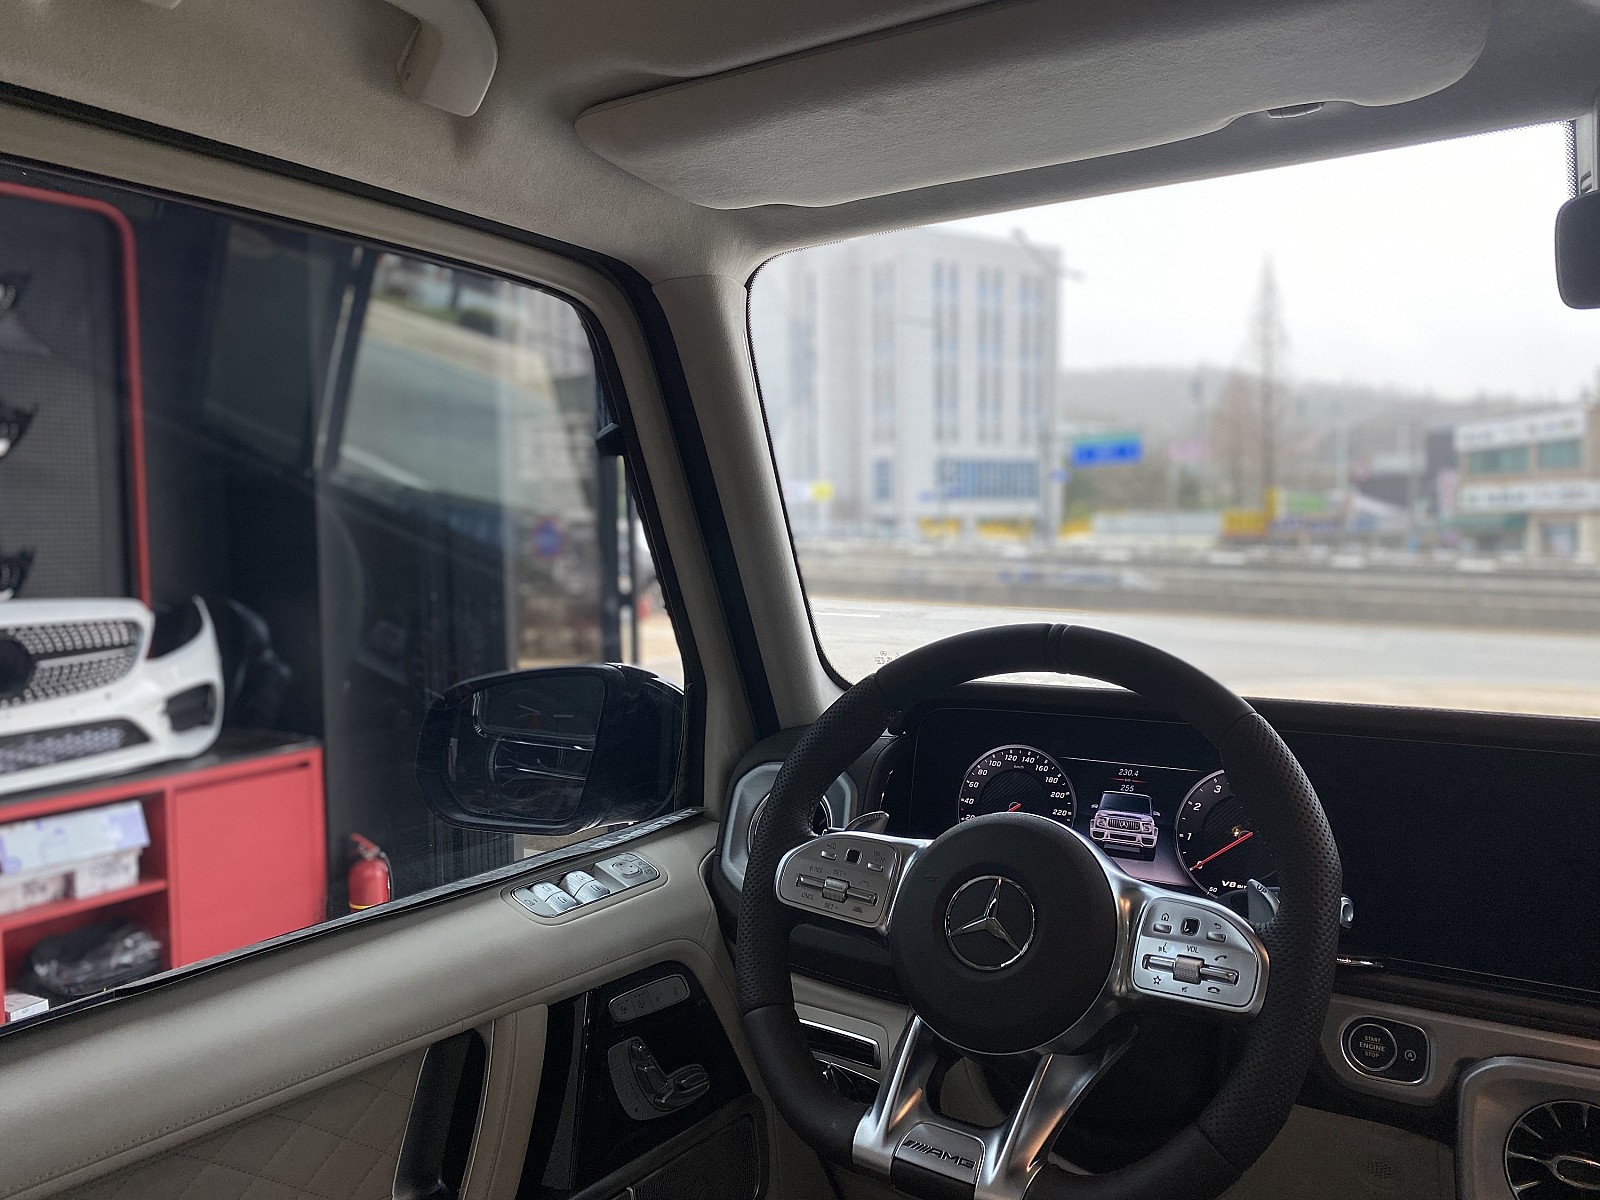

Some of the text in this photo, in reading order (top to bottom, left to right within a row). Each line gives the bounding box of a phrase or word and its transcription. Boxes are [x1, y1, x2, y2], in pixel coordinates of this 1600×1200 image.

[1005, 754, 1017, 762] 120
[1021, 756, 1035, 764] 140
[1035, 764, 1048, 772] 160
[1118, 768, 1139, 777] 230.4
[1045, 776, 1058, 784] 180
[1120, 784, 1135, 792] 255
[1213, 784, 1222, 794] 3
[1050, 791, 1065, 799] 200
[1193, 802, 1202, 811] 2
[1186, 832, 1192, 840] 1
[1222, 880, 1237, 888] V8
[1256, 884, 1268, 893] UP
[1187, 945, 1199, 953] VOL
[1364, 1035, 1381, 1043] START
[1359, 1041, 1386, 1053] ENGINE
